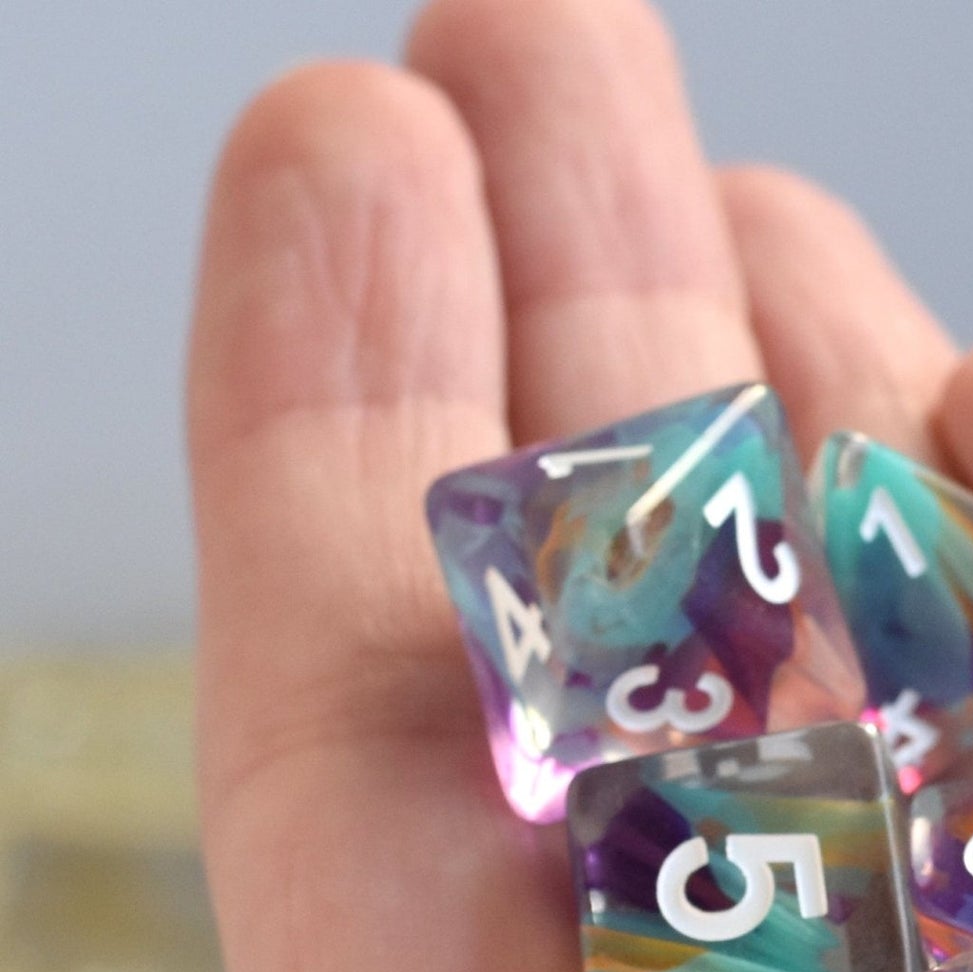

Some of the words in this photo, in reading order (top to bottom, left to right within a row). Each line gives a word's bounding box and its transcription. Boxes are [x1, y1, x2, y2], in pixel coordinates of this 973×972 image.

[538, 444, 653, 479] 1
[703, 472, 800, 604] 2
[859, 486, 926, 579] 1
[485, 565, 551, 682] 4
[605, 664, 734, 732] 3
[656, 833, 829, 942] 5
